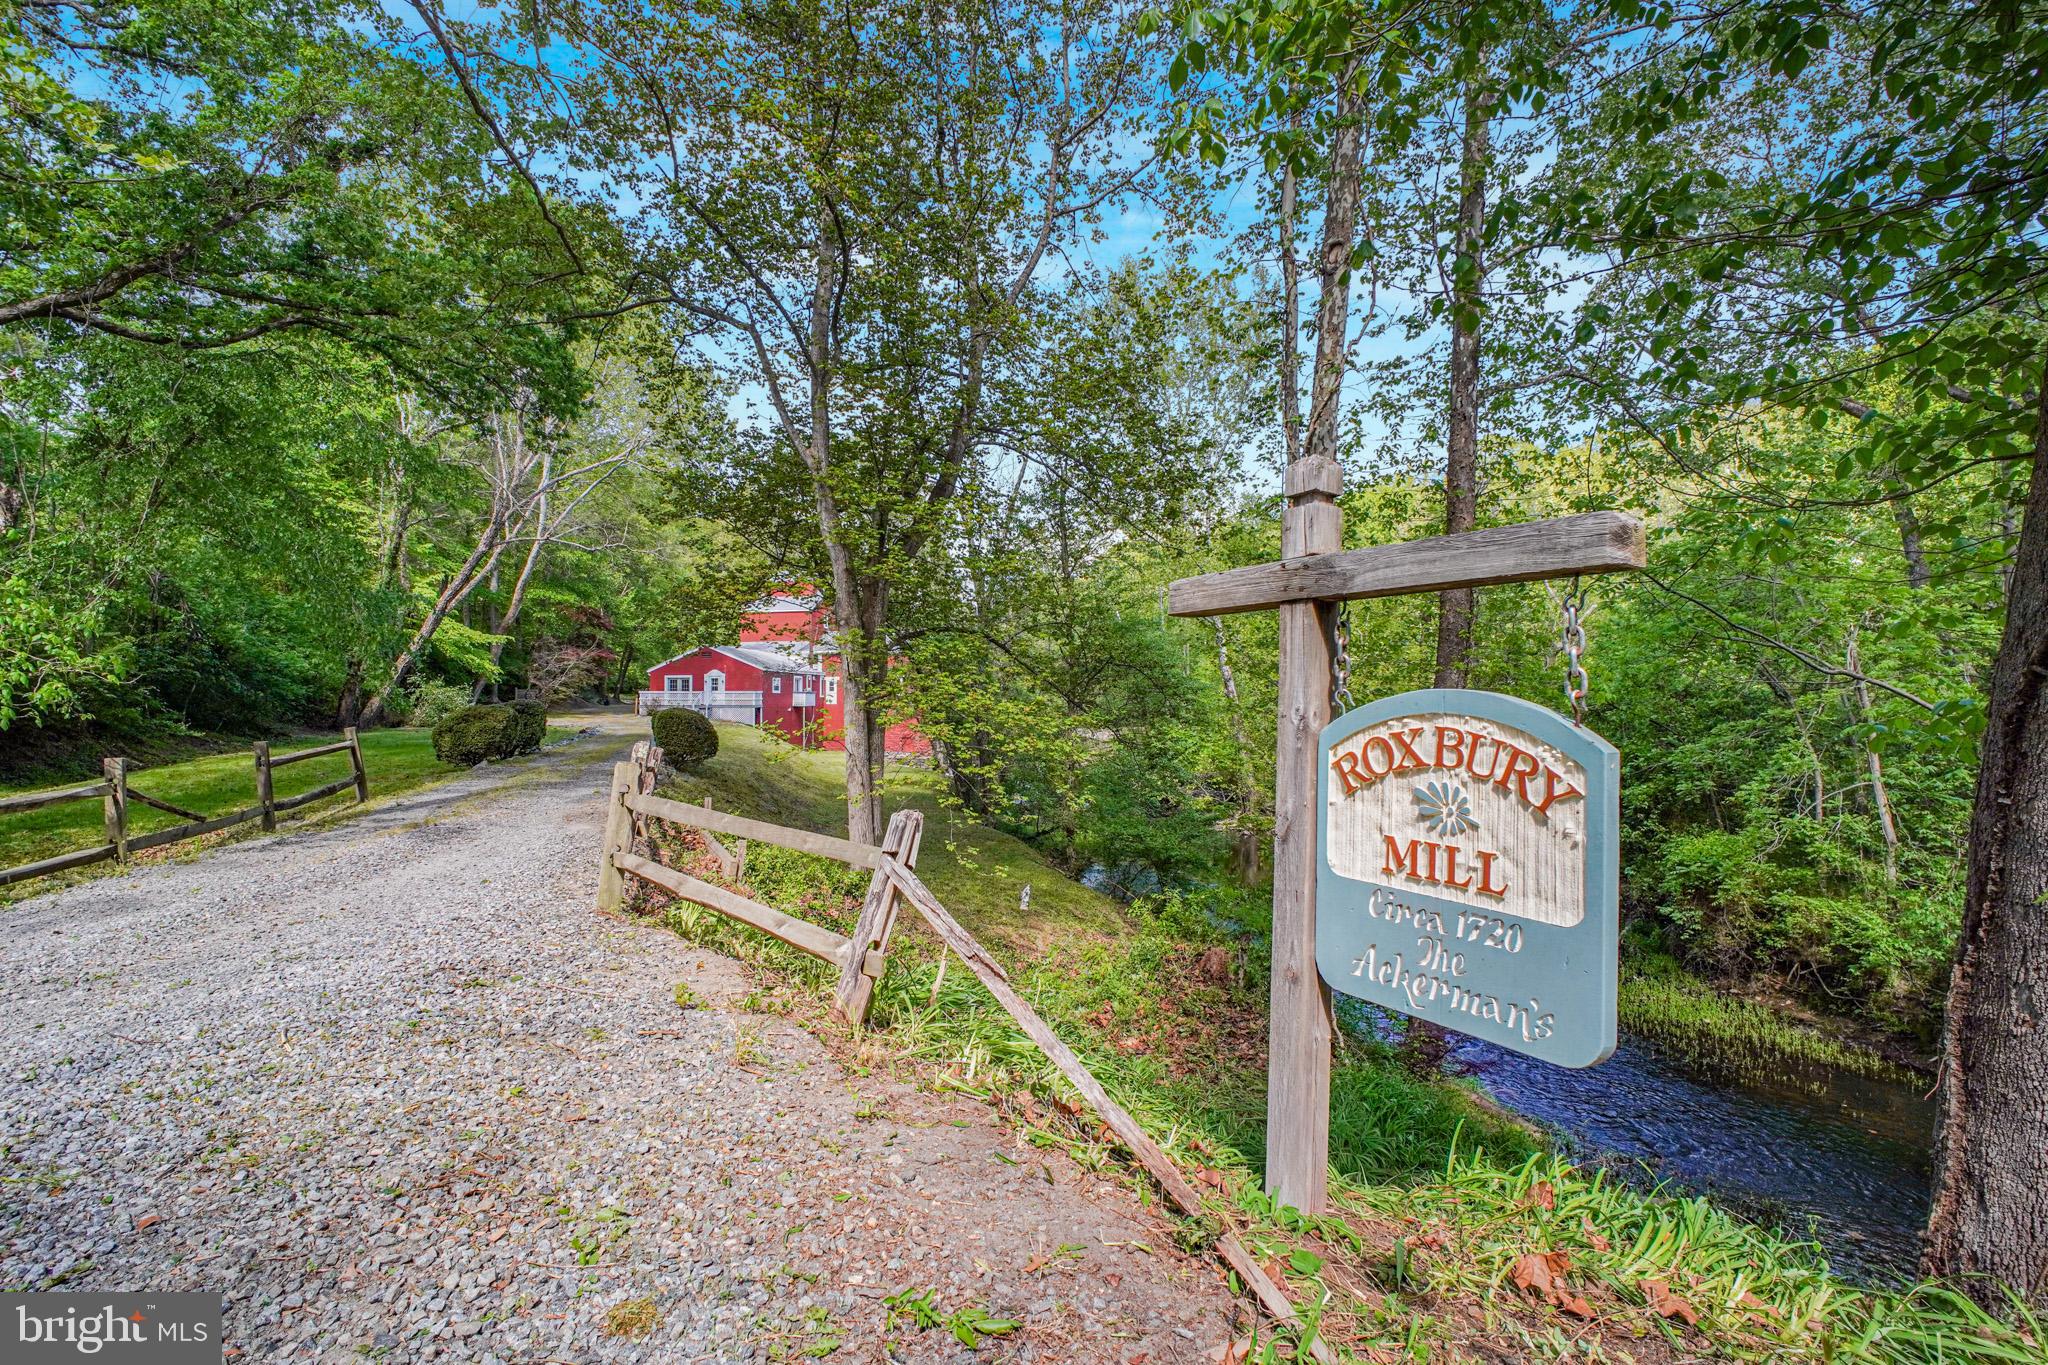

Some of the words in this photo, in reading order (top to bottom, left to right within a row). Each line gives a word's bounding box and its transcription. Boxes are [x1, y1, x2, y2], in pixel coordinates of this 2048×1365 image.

[1331, 725, 1586, 819] ROXBURY
[1381, 834, 1509, 898] MILL
[1368, 888, 1448, 936] Circa
[1456, 909, 1524, 954] 1720
[1416, 934, 1468, 978] The
[1351, 942, 1556, 1043] Ackerman's
